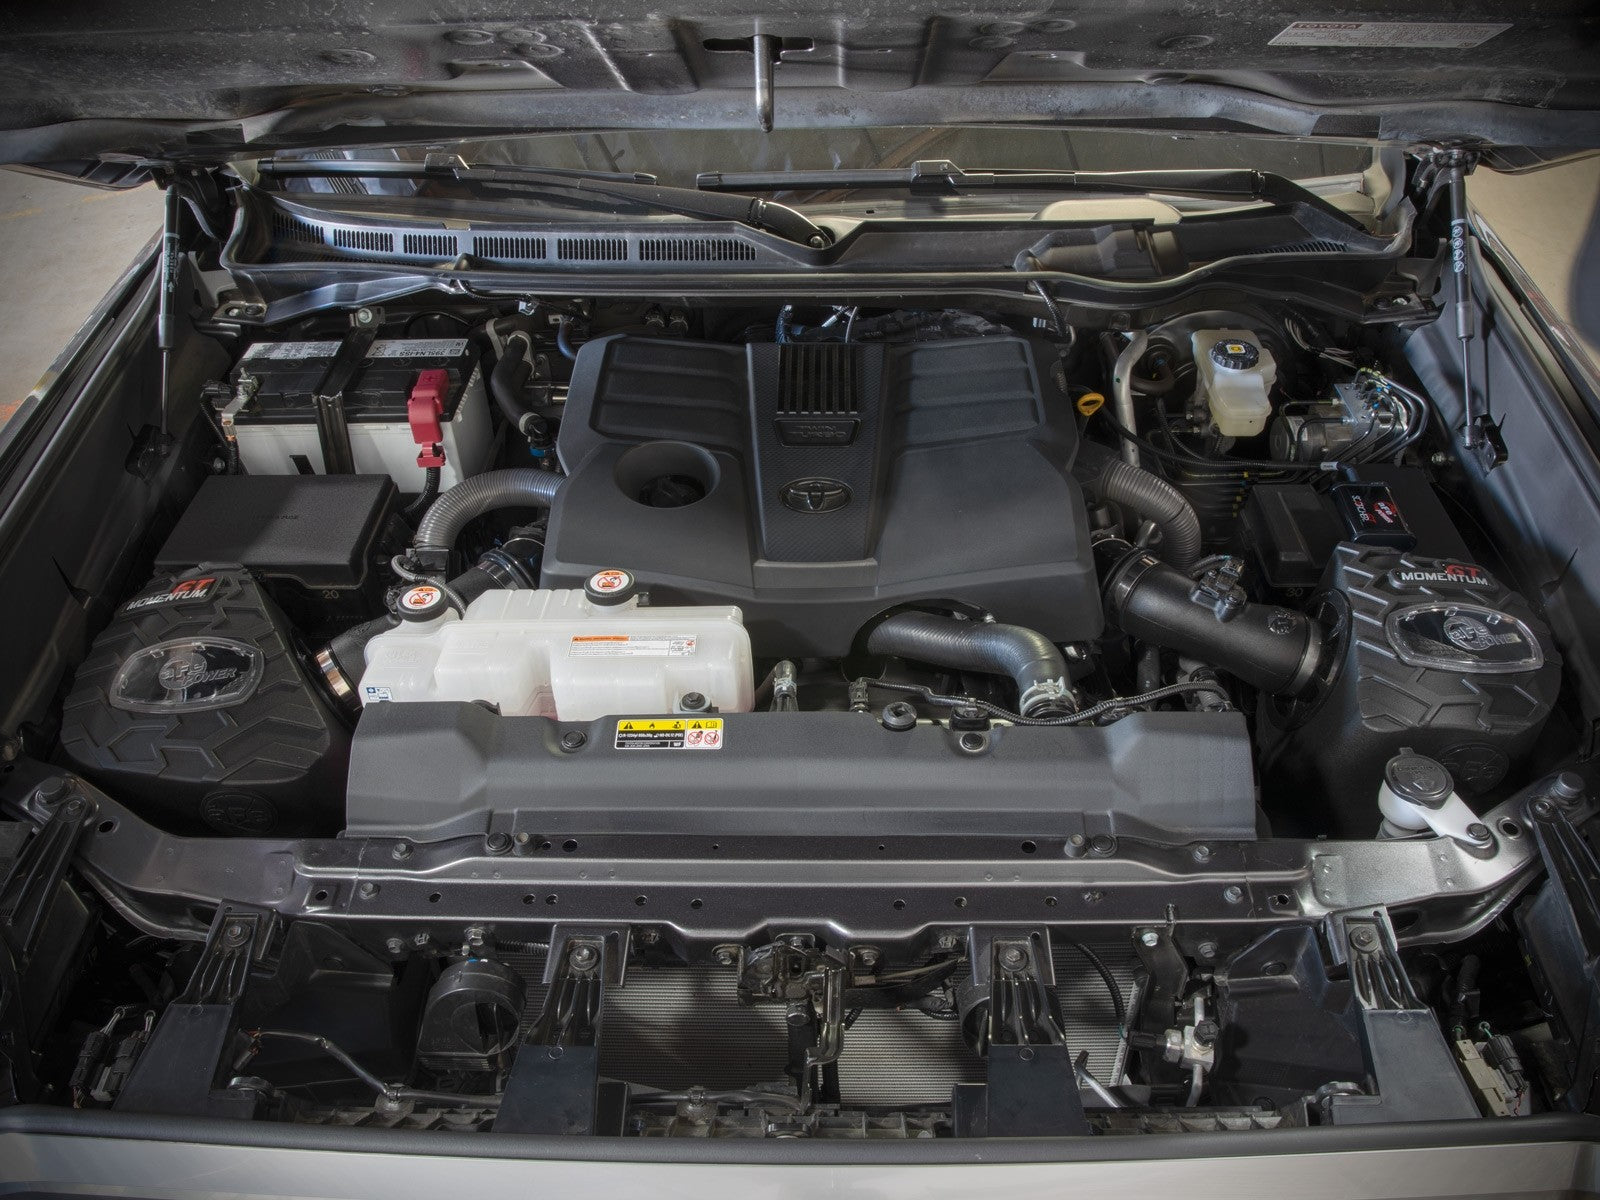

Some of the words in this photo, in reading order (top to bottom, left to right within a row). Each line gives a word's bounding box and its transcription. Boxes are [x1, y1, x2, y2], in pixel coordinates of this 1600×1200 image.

[1446, 564, 1481, 576] GT
[1402, 572, 1489, 586] MOMENTUM
[171, 578, 217, 594] GT
[322, 590, 339, 599] 20
